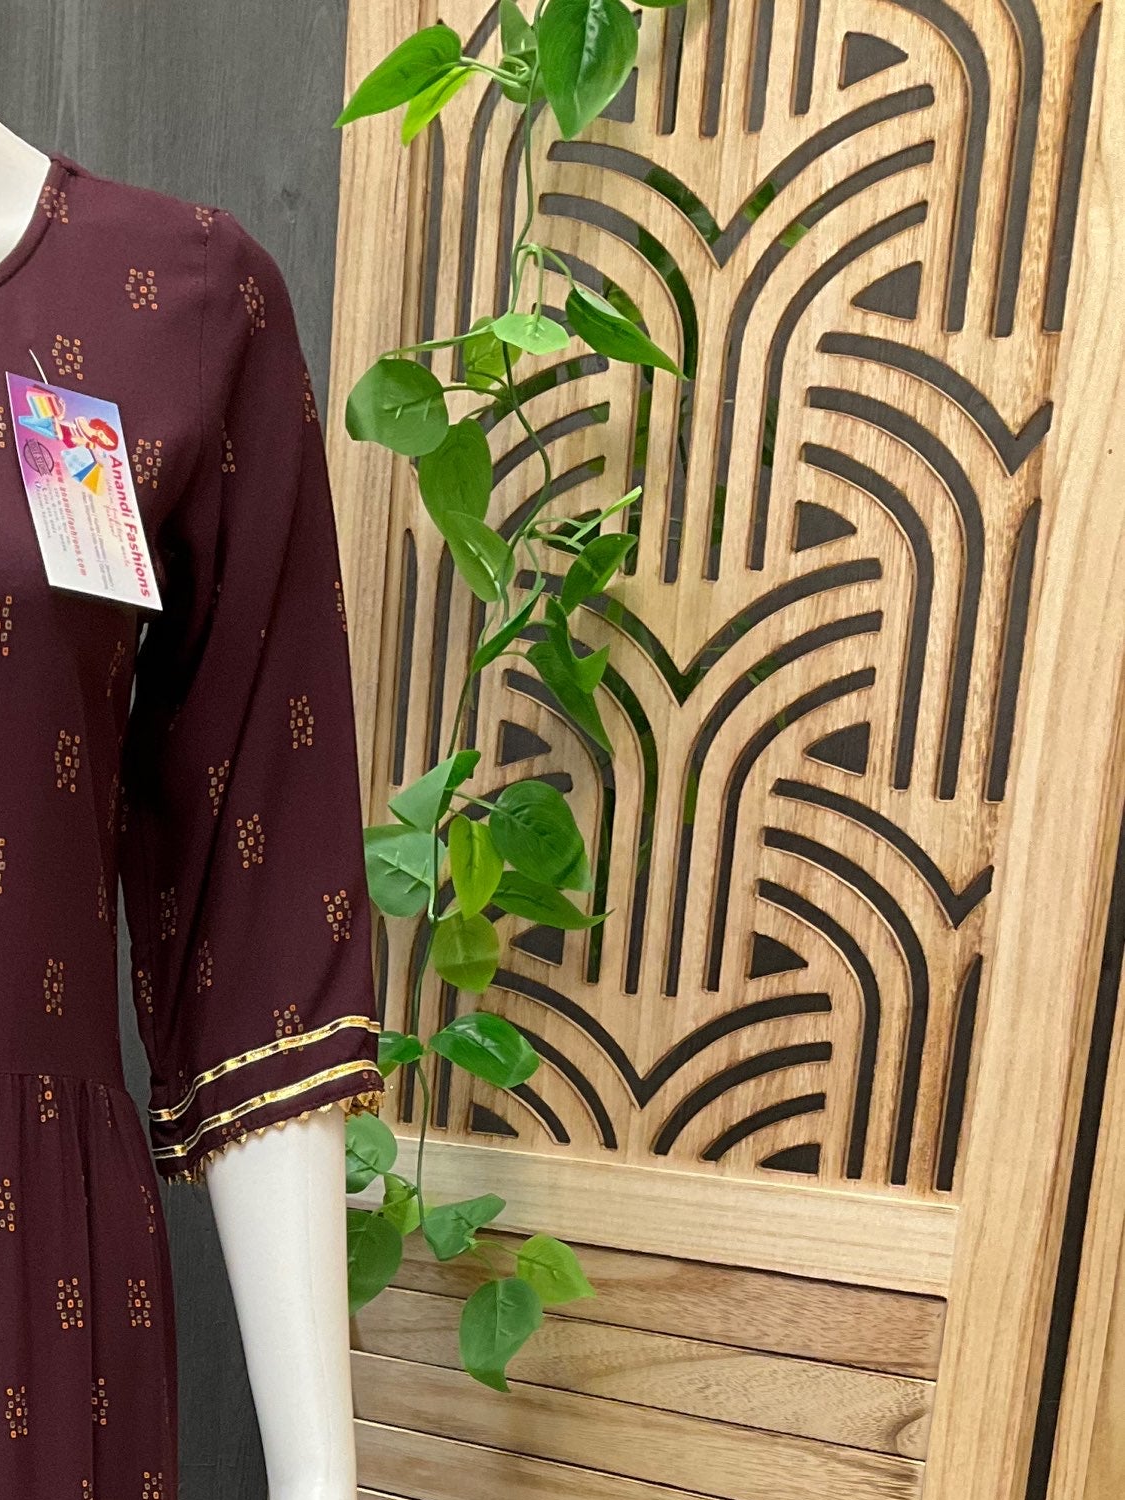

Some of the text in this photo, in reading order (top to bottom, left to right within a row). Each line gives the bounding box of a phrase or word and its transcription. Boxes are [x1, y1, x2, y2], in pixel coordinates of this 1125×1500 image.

[53, 461, 87, 576] www.anandifashions.com
[110, 455, 135, 519] Anandi
[124, 522, 151, 598] Fashions
